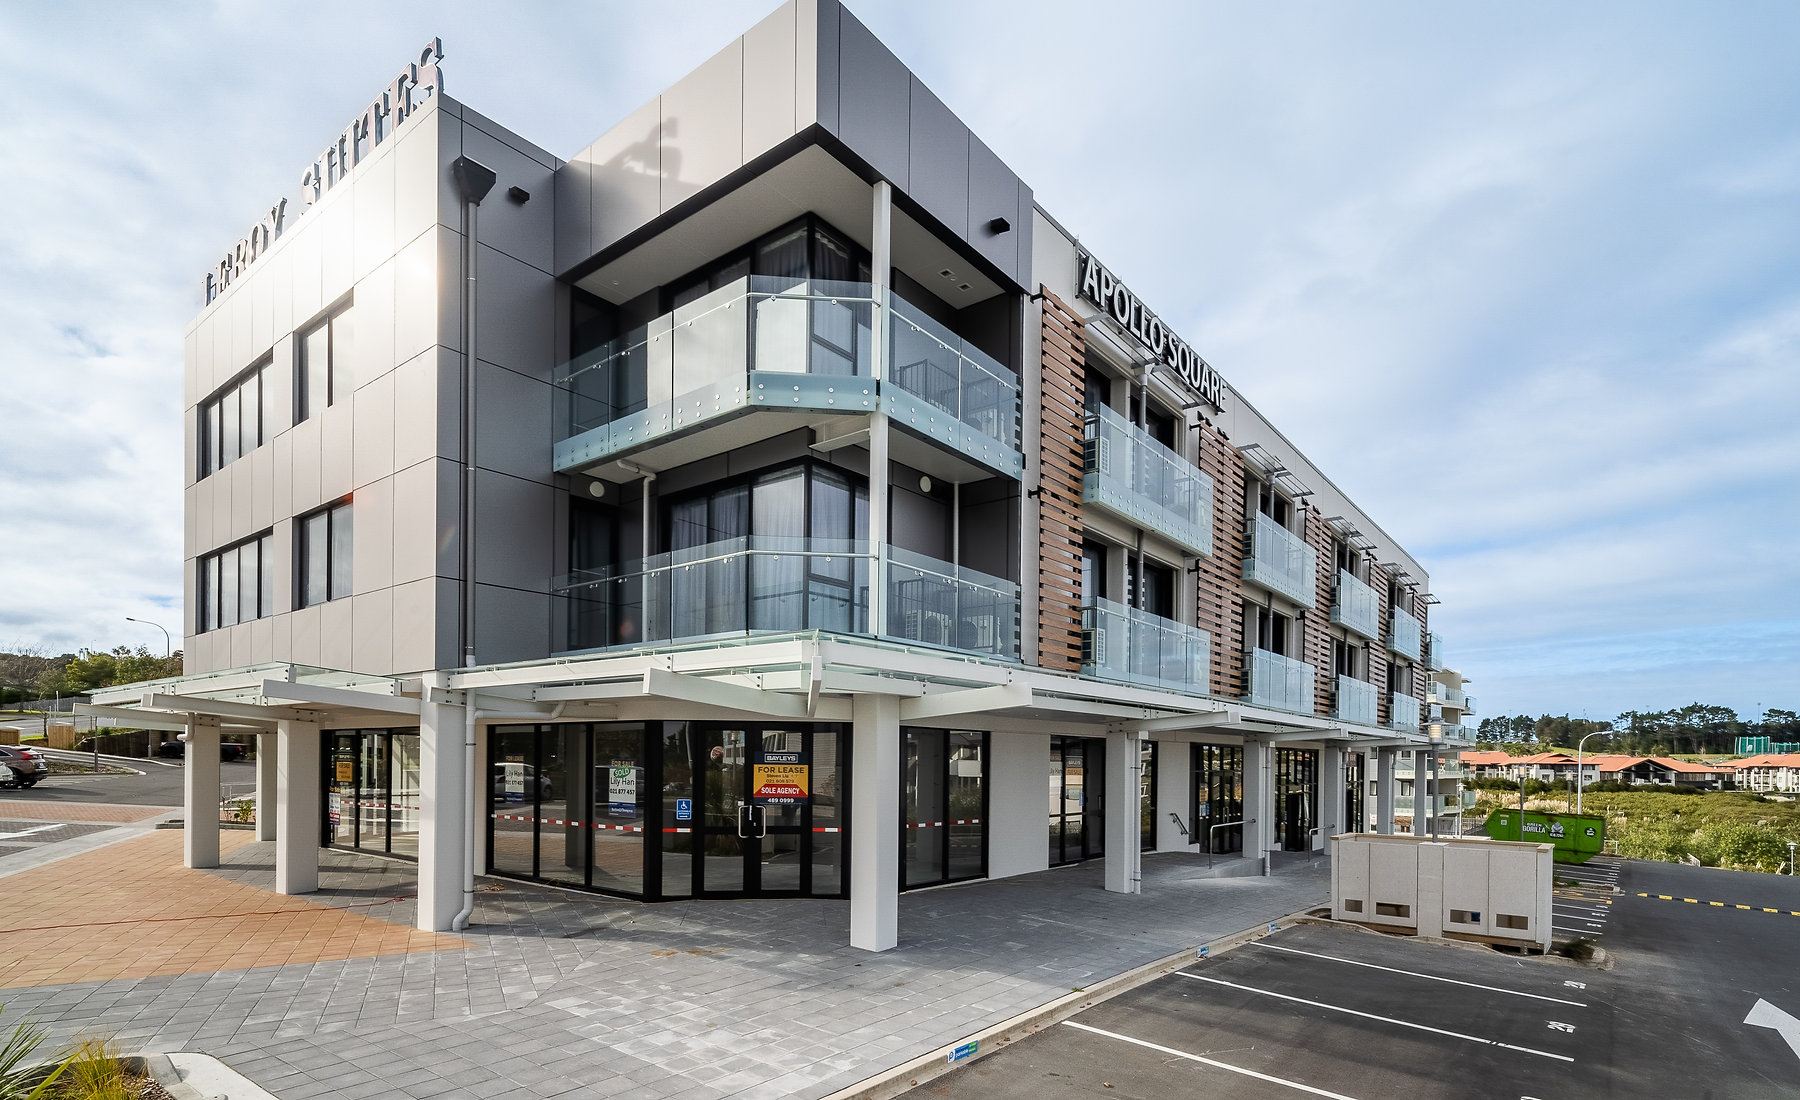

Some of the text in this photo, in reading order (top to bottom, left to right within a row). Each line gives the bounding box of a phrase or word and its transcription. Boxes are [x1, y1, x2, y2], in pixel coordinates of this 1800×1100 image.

[1083, 255, 1225, 412] APOLLO SQUARE
[614, 768, 630, 777] SOLD
[610, 776, 635, 786] Lily Han
